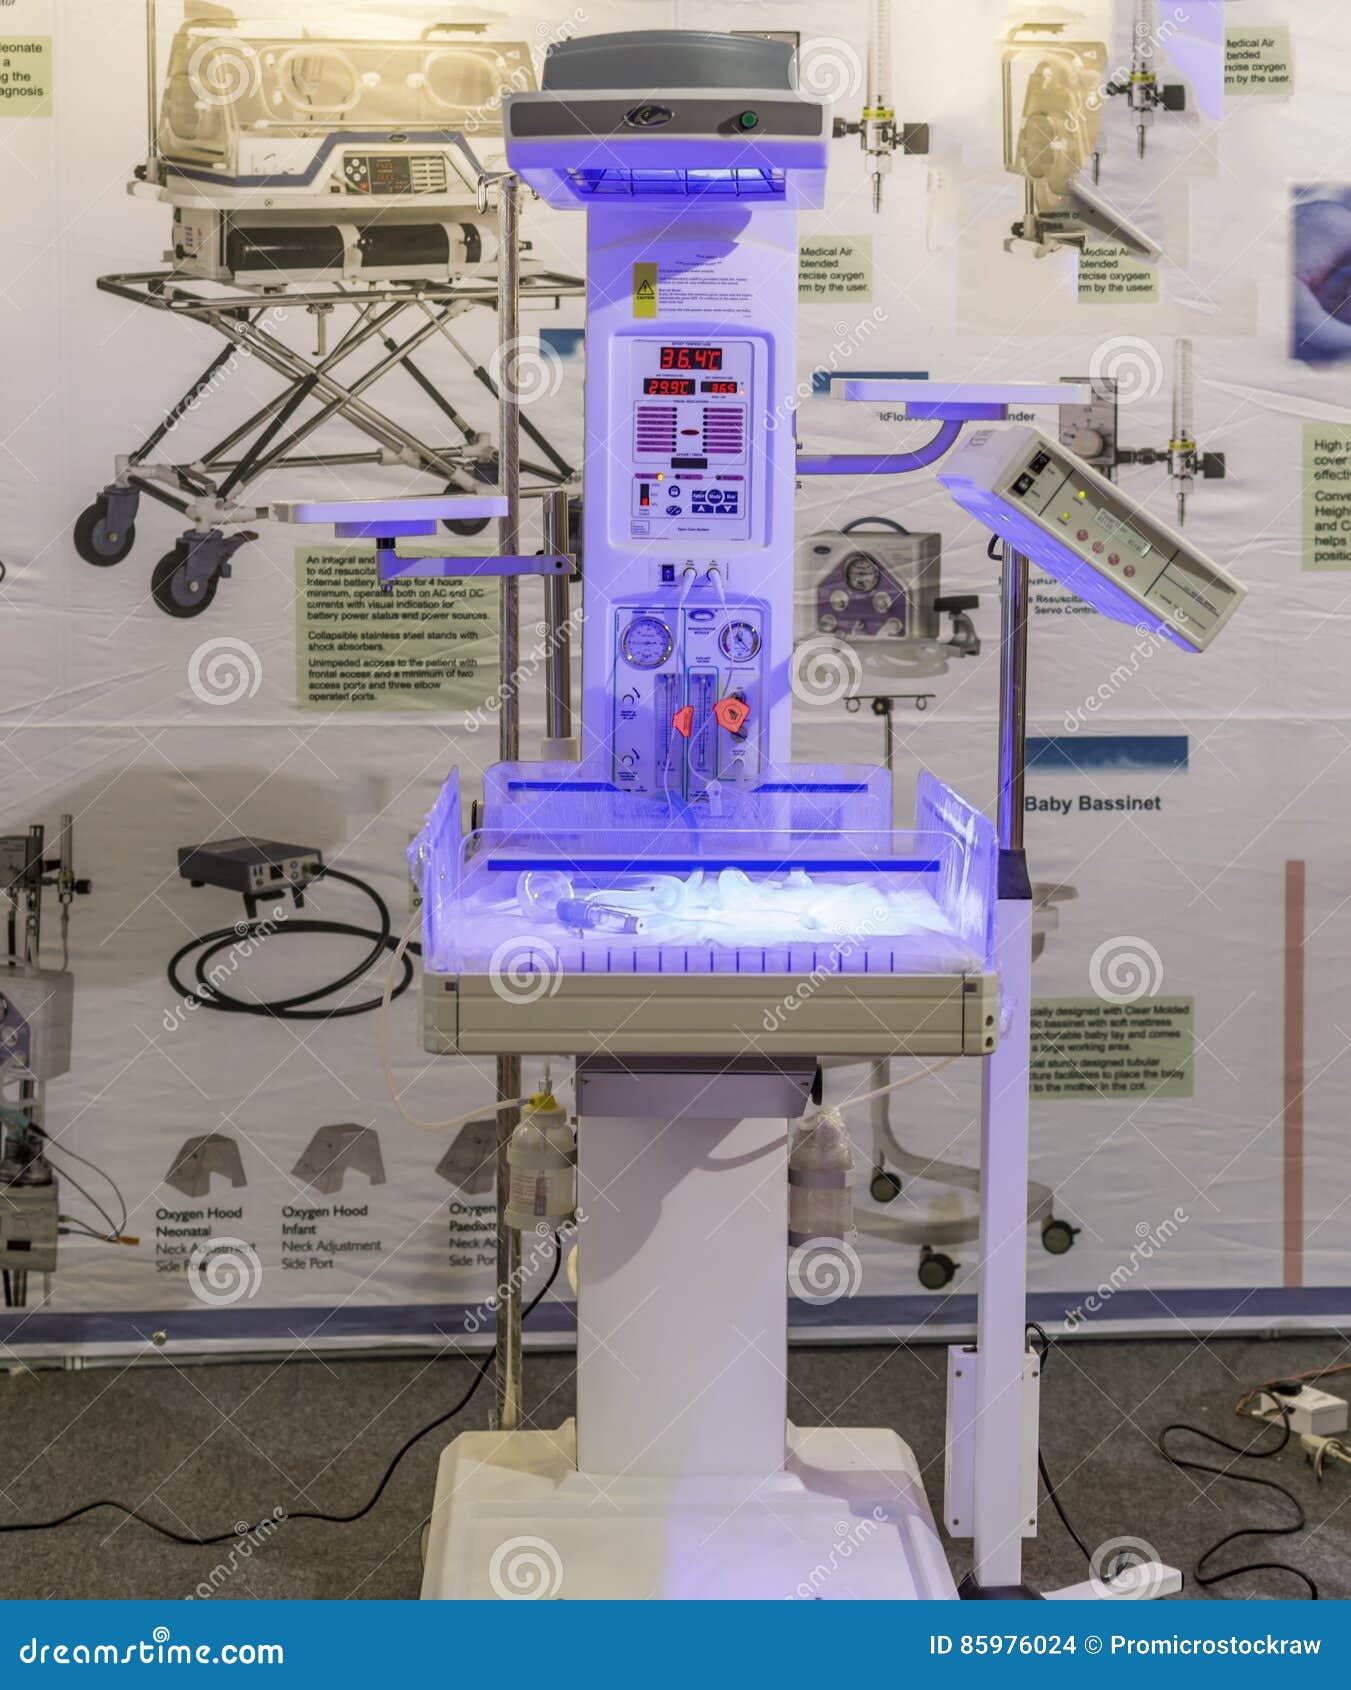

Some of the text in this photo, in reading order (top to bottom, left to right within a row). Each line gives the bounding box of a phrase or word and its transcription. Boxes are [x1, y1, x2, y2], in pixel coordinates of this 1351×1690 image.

[1261, 39, 1275, 48] Air
[12, 71, 31, 81] the
[1251, 75, 1266, 83] the
[801, 247, 853, 256] Medical Air
[801, 260, 839, 268] blended
[829, 272, 864, 282] oxygen
[815, 284, 826, 294] by
[829, 284, 843, 292] the
[1094, 284, 1123, 294] by the
[1314, 440, 1342, 453] High
[1314, 456, 1347, 465] cover
[1314, 521, 1337, 531] and
[1314, 536, 1347, 547] helps
[307, 556, 320, 565] An
[358, 556, 375, 565] and
[307, 567, 316, 576] to
[344, 578, 375, 589] battery
[414, 578, 426, 587] for
[437, 578, 463, 587] hours
[396, 589, 416, 598] both
[419, 589, 430, 598] on
[432, 589, 447, 598] AC
[449, 589, 466, 598] and
[469, 589, 484, 598] DC
[346, 600, 365, 609] with
[368, 600, 394, 609] visual
[396, 600, 440, 609] indication
[442, 600, 455, 609] for
[1035, 605, 1062, 614] Servo
[307, 612, 338, 622] battery
[341, 613, 369, 622] power
[401, 612, 419, 621] and
[421, 613, 449, 622] power
[308, 631, 358, 641] Collapsible
[361, 631, 400, 640] stainless
[427, 631, 457, 640] stands
[460, 631, 478, 640] with
[309, 642, 335, 651] shock
[309, 659, 478, 669] Unimpeded access to the patient with
[309, 670, 337, 679] frontal
[374, 670, 391, 679] and
[402, 670, 443, 679] minimum
[446, 670, 455, 679] of
[457, 670, 473, 679] two
[309, 682, 340, 690] access
[369, 681, 385, 690] and
[388, 681, 412, 690] three
[414, 681, 440, 690] elbow
[1025, 795, 1162, 815] Baby Bassinet
[1056, 1006, 1100, 1017] designed
[1103, 1006, 1122, 1015] with
[1088, 1019, 1107, 1027] with
[1110, 1019, 1127, 1027] soft
[1084, 1031, 1107, 1040] baby
[1068, 1044, 1105, 1053] working
[1080, 1059, 1124, 1068] designed
[1103, 1071, 1112, 1079] to
[1143, 1071, 1158, 1079] the
[1046, 1084, 1061, 1092] the
[1112, 1083, 1126, 1091] the
[156, 1207, 242, 1222] Oxygen Hood
[282, 1205, 368, 1220] Oxygen Hood
[156, 1225, 211, 1237] Neonatal
[282, 1224, 316, 1235] Infant
[282, 1240, 382, 1255] Neck Adjustment
[449, 1238, 479, 1249] Neck
[156, 1243, 186, 1255] Neck
[282, 1258, 334, 1270] Side Port
[449, 1255, 472, 1266] Side
[156, 1260, 180, 1272] Side
